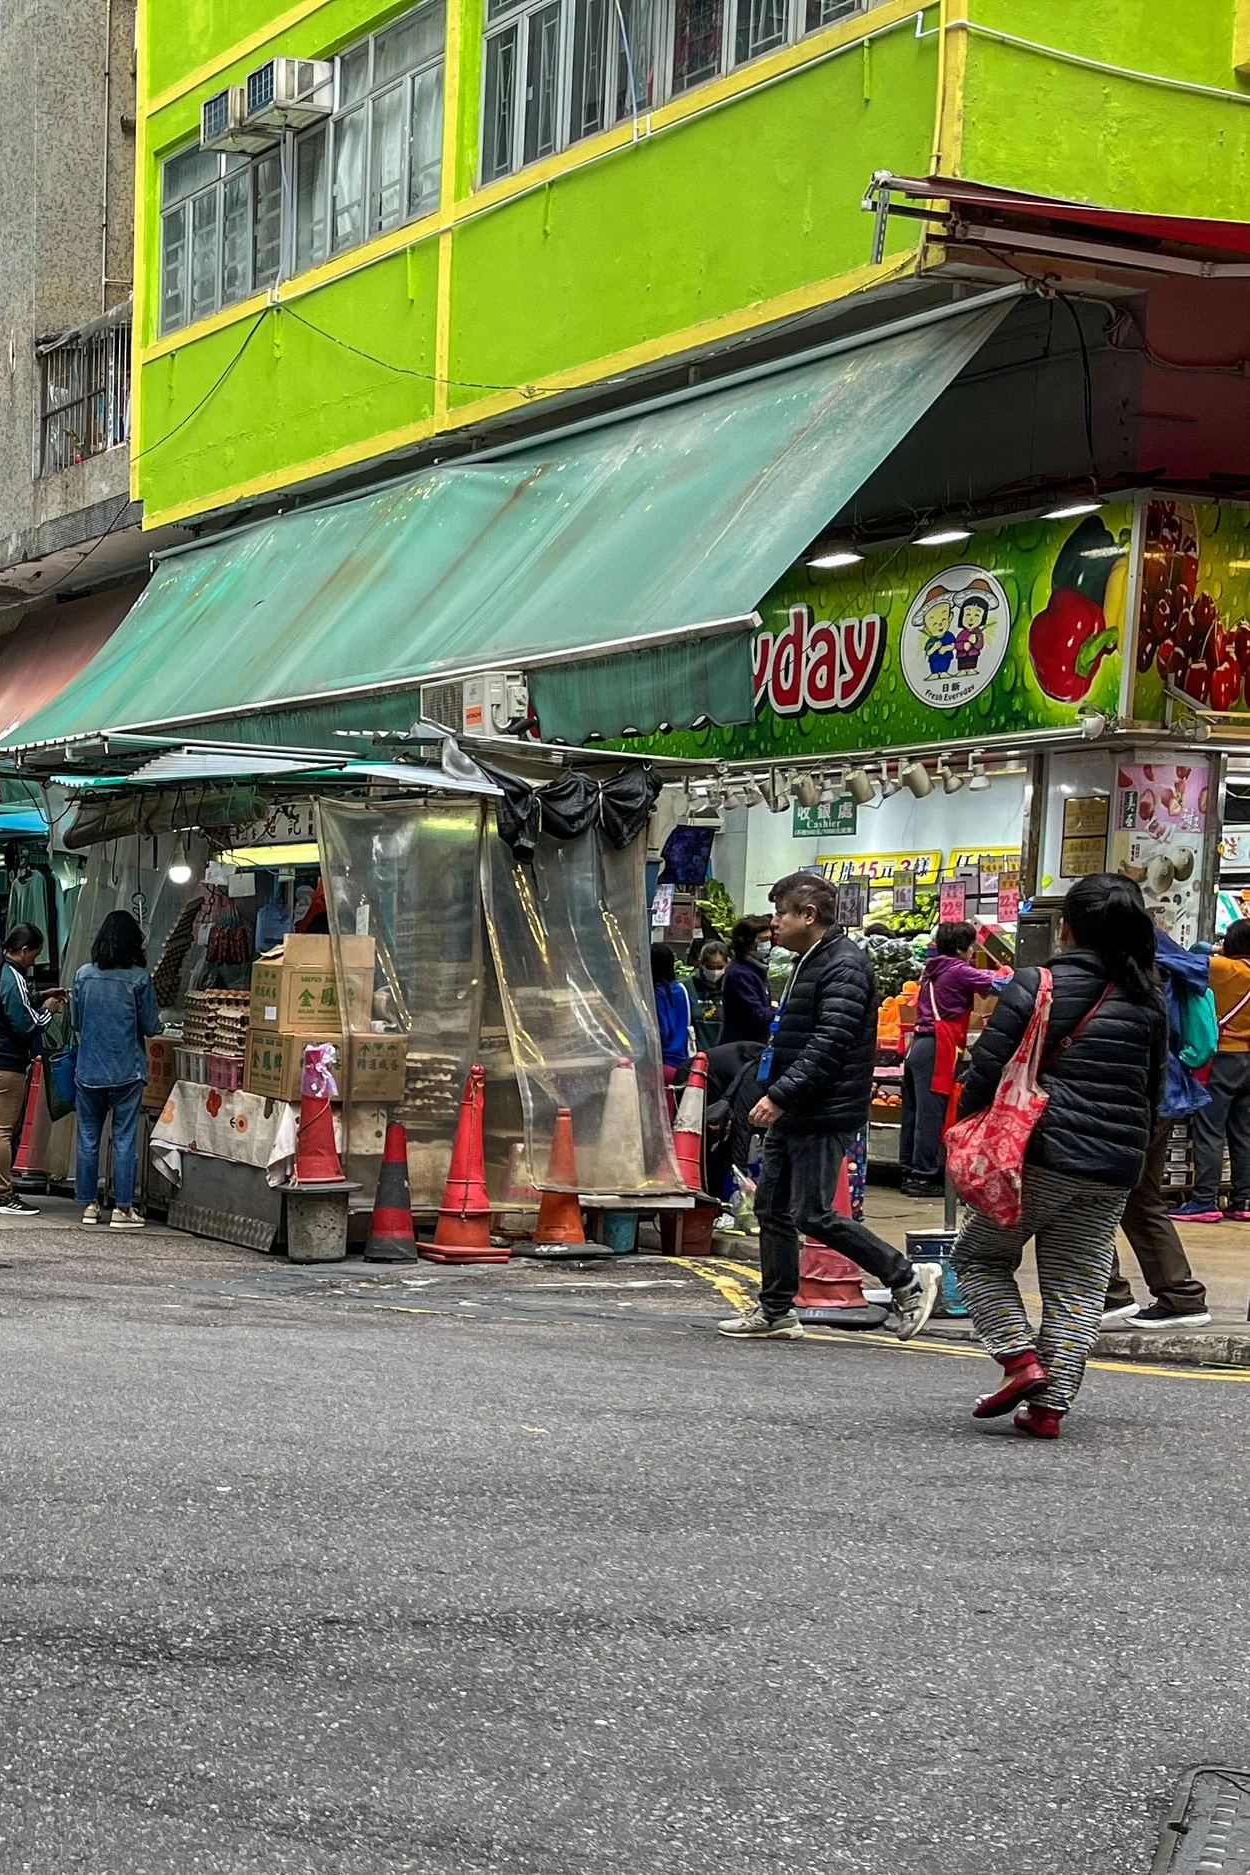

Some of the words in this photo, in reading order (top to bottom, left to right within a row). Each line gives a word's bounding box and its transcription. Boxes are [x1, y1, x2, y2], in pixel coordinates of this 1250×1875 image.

[924, 688, 943, 701] Fresh
[943, 683, 975, 701] Everyday
[796, 801, 854, 821] 收銀處
[806, 819, 842, 829] Cashier
